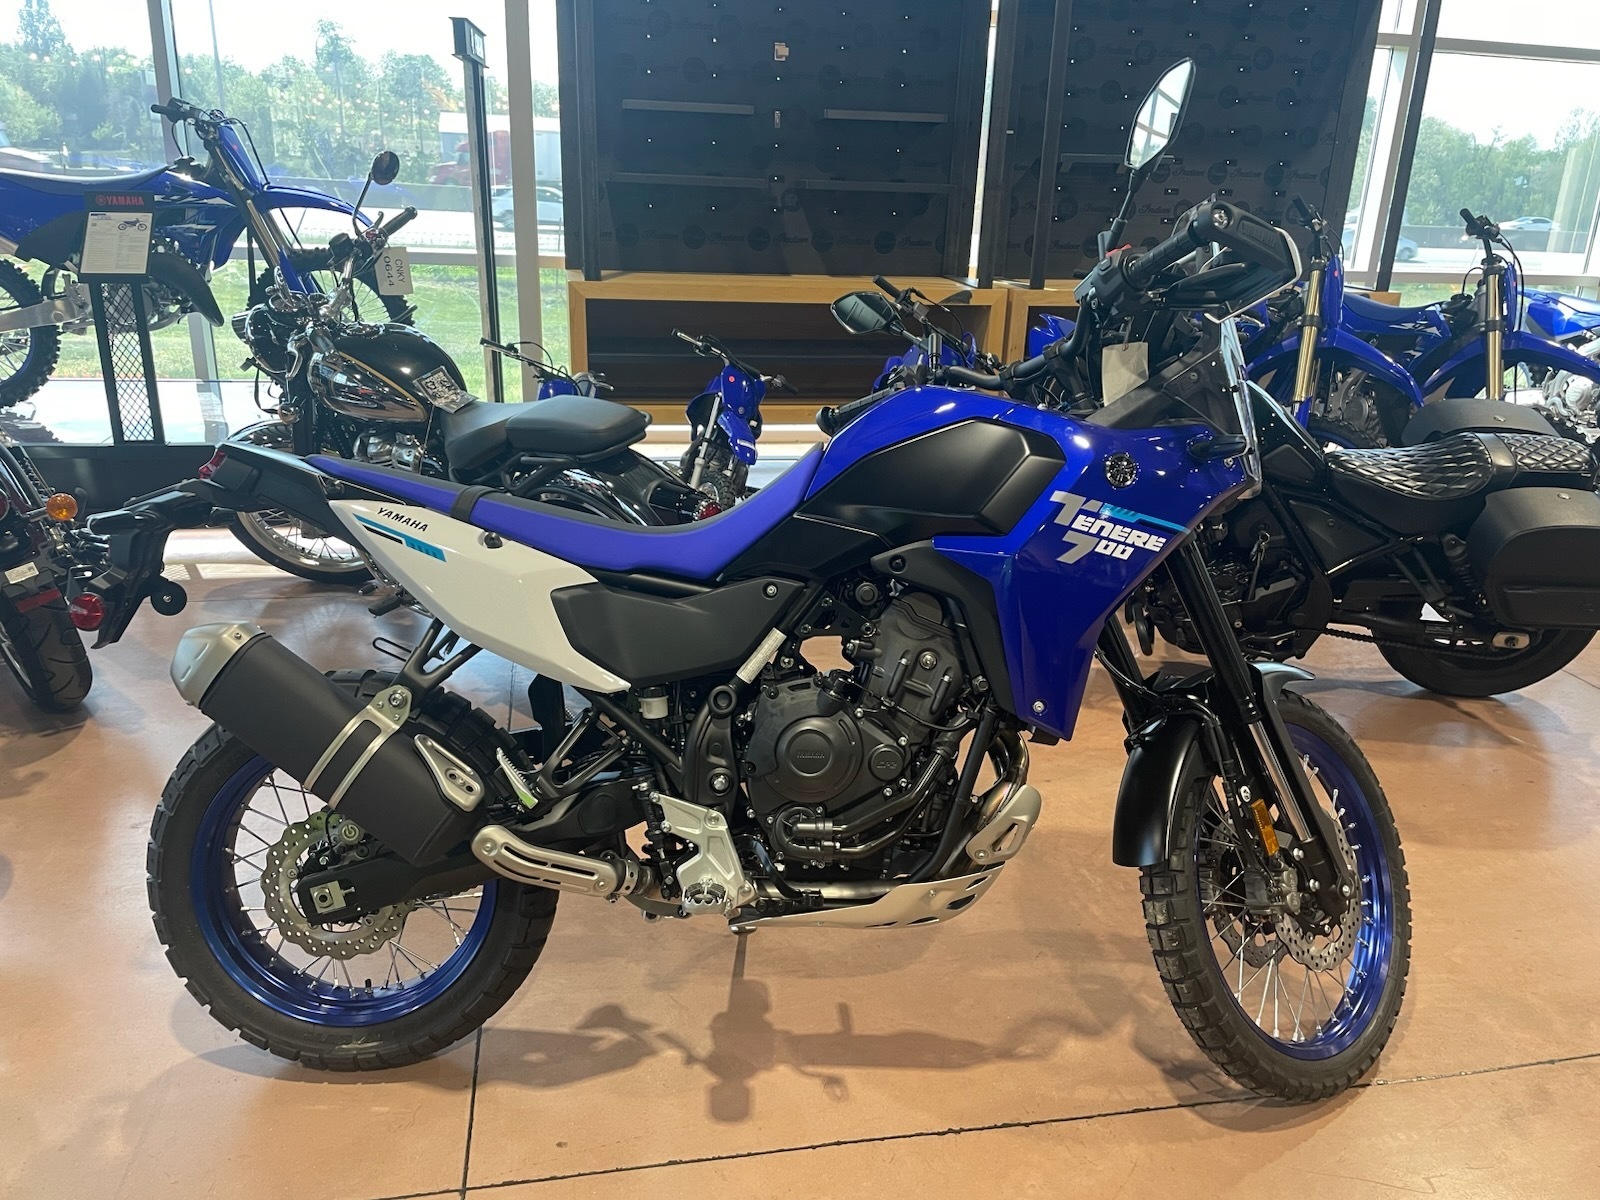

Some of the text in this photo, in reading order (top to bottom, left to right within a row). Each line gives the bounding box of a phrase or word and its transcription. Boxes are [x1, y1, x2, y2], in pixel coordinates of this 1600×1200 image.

[105, 195, 144, 206] YAMAHA
[394, 258, 406, 283] CNKY
[377, 507, 428, 532] YAMAHA
[1056, 530, 1135, 565] 700
